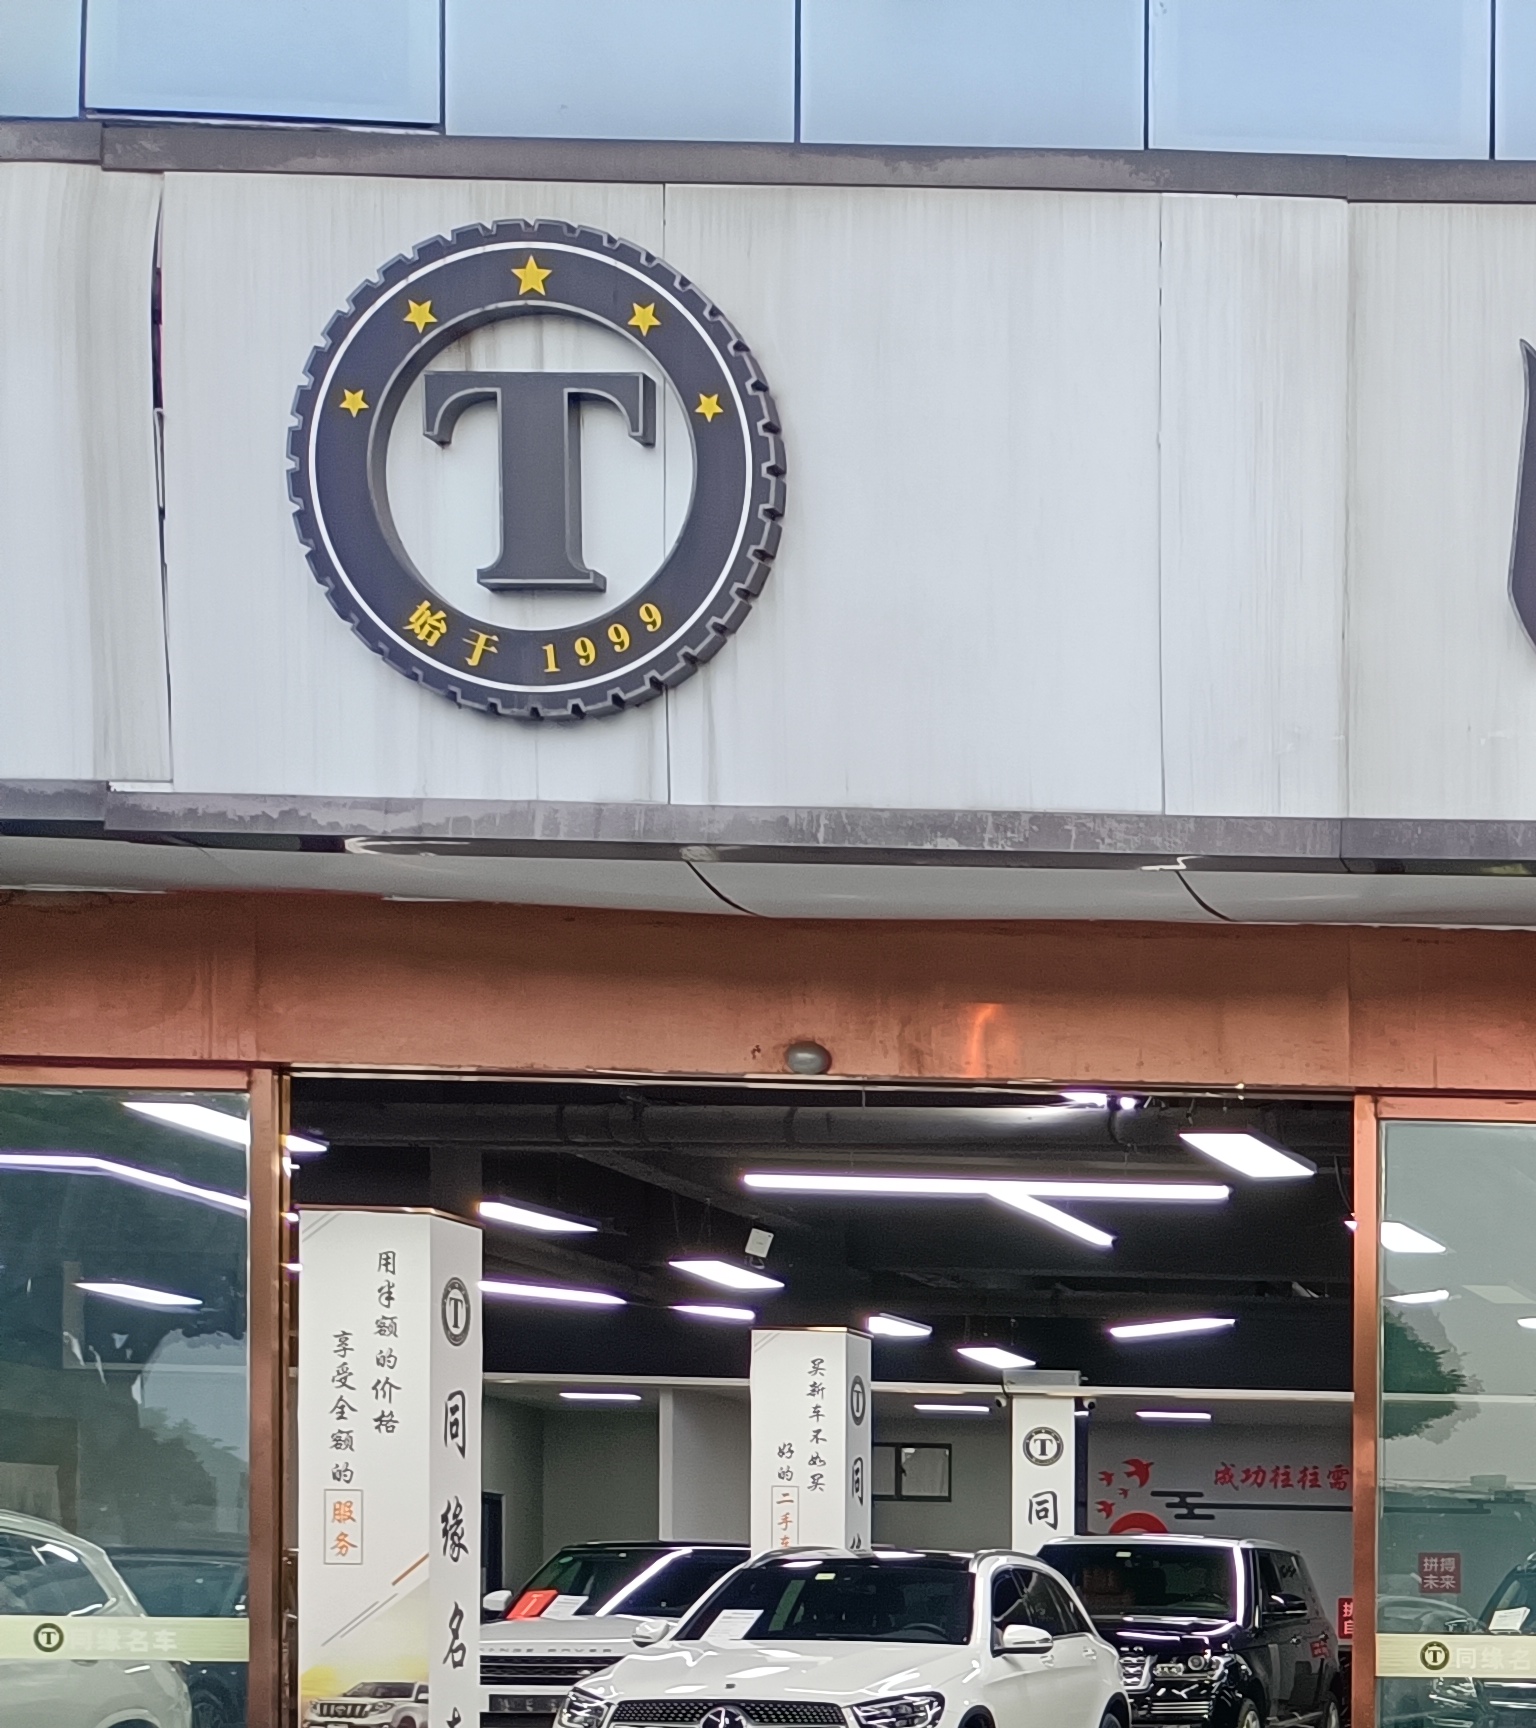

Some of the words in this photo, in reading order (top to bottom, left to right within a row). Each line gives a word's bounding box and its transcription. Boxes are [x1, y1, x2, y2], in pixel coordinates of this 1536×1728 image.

[422, 372, 657, 592] T
[403, 600, 499, 666] 始于
[542, 603, 662, 672] 1999
[372, 1250, 402, 1434] 用半额的价格
[806, 1357, 828, 1492] 买新车不如买
[1423, 1574, 1456, 1590] 未来
